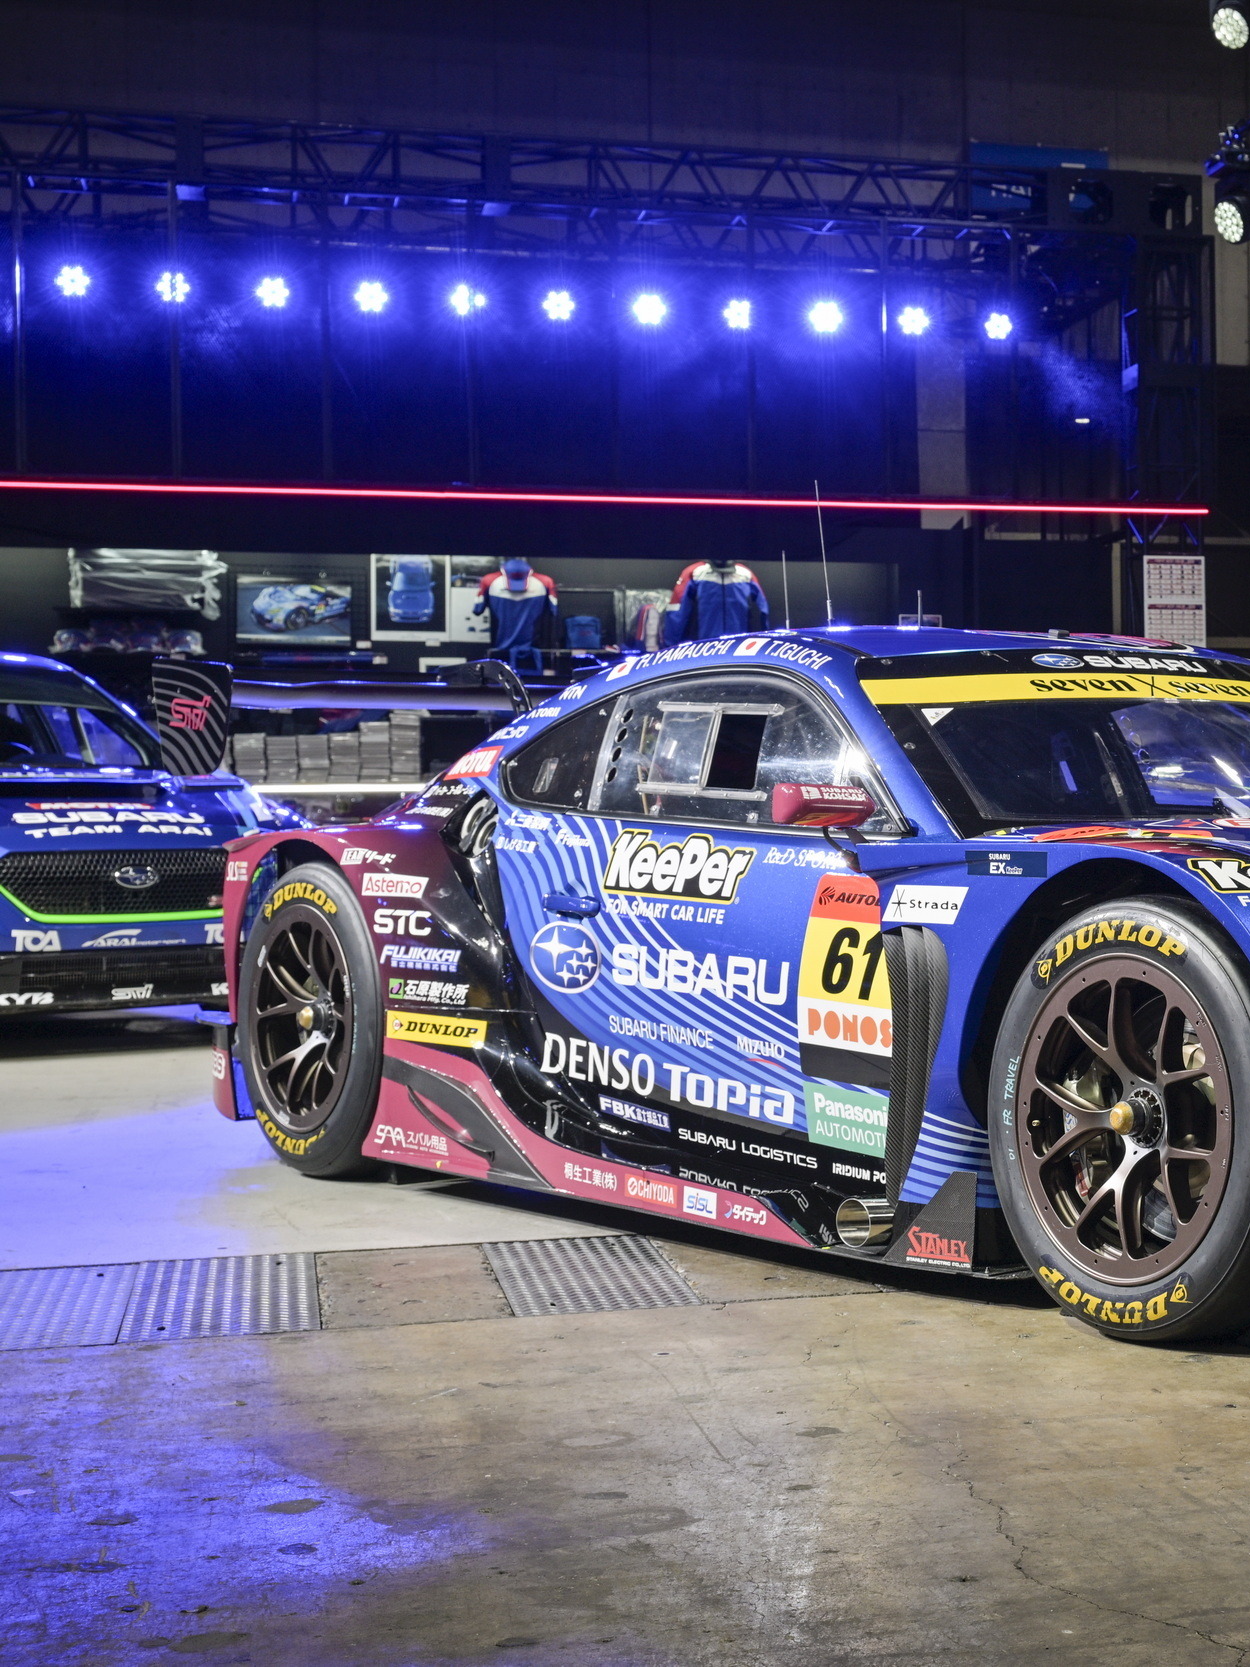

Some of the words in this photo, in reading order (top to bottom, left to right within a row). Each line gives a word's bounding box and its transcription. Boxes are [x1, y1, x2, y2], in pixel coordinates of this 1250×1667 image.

[1082, 655, 1208, 674] SUBARU
[1029, 678, 1138, 693] seven
[12, 811, 205, 825] SUBARU
[24, 825, 123, 839] TEAM
[137, 825, 213, 837] ARAI
[605, 831, 753, 898] KeePer
[988, 853, 1011, 861] SUBARU
[989, 862, 1006, 875] EX
[364, 876, 423, 894] Astemo
[273, 882, 339, 915] DUNLOP
[909, 898, 959, 911] Strada
[373, 907, 432, 937] STC
[605, 899, 628, 917] FOR
[629, 904, 667, 920] SMART
[669, 907, 694, 923] CAR
[695, 907, 726, 926] LIFE
[379, 944, 462, 965] FUJIKIKAI
[1055, 919, 1187, 968] DUNLOP
[611, 942, 790, 1006] SUBARU
[821, 926, 884, 1001] 61
[404, 979, 470, 1000] 石原製作所
[404, 1020, 479, 1039] DUNLOP
[608, 1014, 658, 1041] SUBARU
[660, 1022, 715, 1050] FINANCE
[807, 1007, 892, 1049] PONOS
[735, 1035, 786, 1060] MIZUHO
[539, 1031, 656, 1097] DENSO
[1004, 1055, 1021, 1100] TRAVEL
[599, 1096, 637, 1120] FBK
[813, 1091, 888, 1128] Panasoni
[406, 1130, 448, 1151] スバル用品
[815, 1119, 887, 1149] AUTOMOTI
[678, 1128, 737, 1151] SUBARU
[741, 1141, 819, 1169] LOGISTICS
[564, 1161, 618, 1192] 桐生工業(株)
[832, 1162, 871, 1181] IRIDIUM
[637, 1179, 675, 1204] CHIYODA
[732, 1203, 767, 1226] ダイテック
[906, 1226, 971, 1263] STANLEY
[1038, 1263, 1169, 1326] DUNLOP
